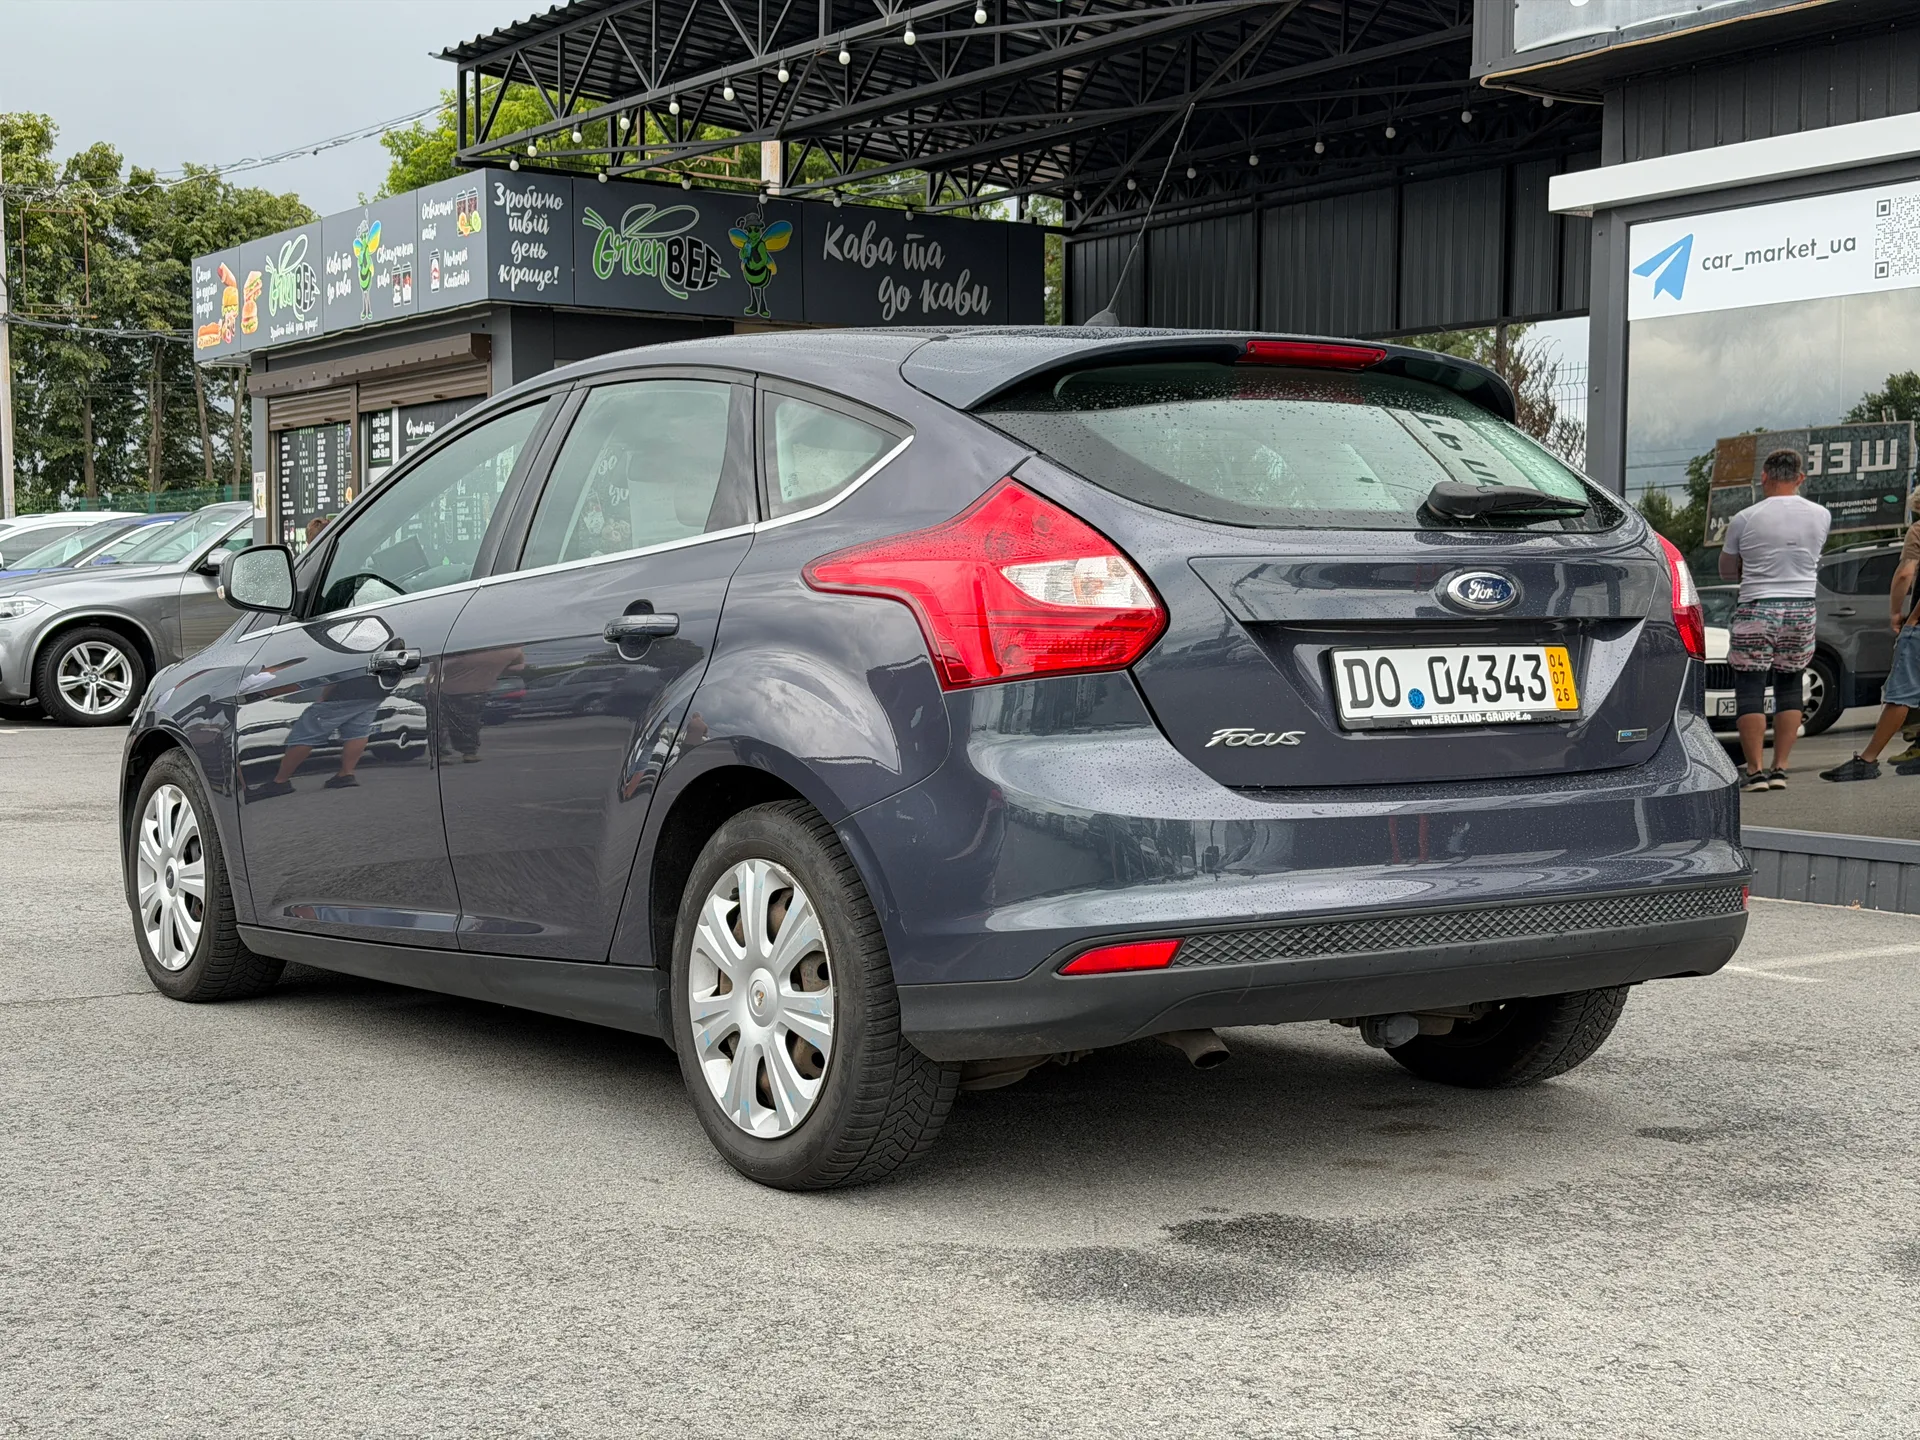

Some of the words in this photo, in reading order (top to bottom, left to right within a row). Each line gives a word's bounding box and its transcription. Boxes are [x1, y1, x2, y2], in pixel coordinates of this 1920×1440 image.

[494, 182, 564, 215] Зробимо
[509, 209, 549, 235] твій
[511, 240, 548, 264] день
[823, 220, 897, 268] Кава
[903, 233, 945, 271] та
[1702, 237, 1856, 271] car_market_ua
[498, 264, 560, 292] краще!
[878, 276, 912, 321] до
[919, 269, 991, 316] кави
[1467, 578, 1502, 599] Ford
[1549, 653, 1564, 668] 04
[1343, 656, 1401, 709] DO
[1427, 653, 1547, 705] 04343
[1552, 670, 1566, 685] 07
[1556, 688, 1570, 702] 26
